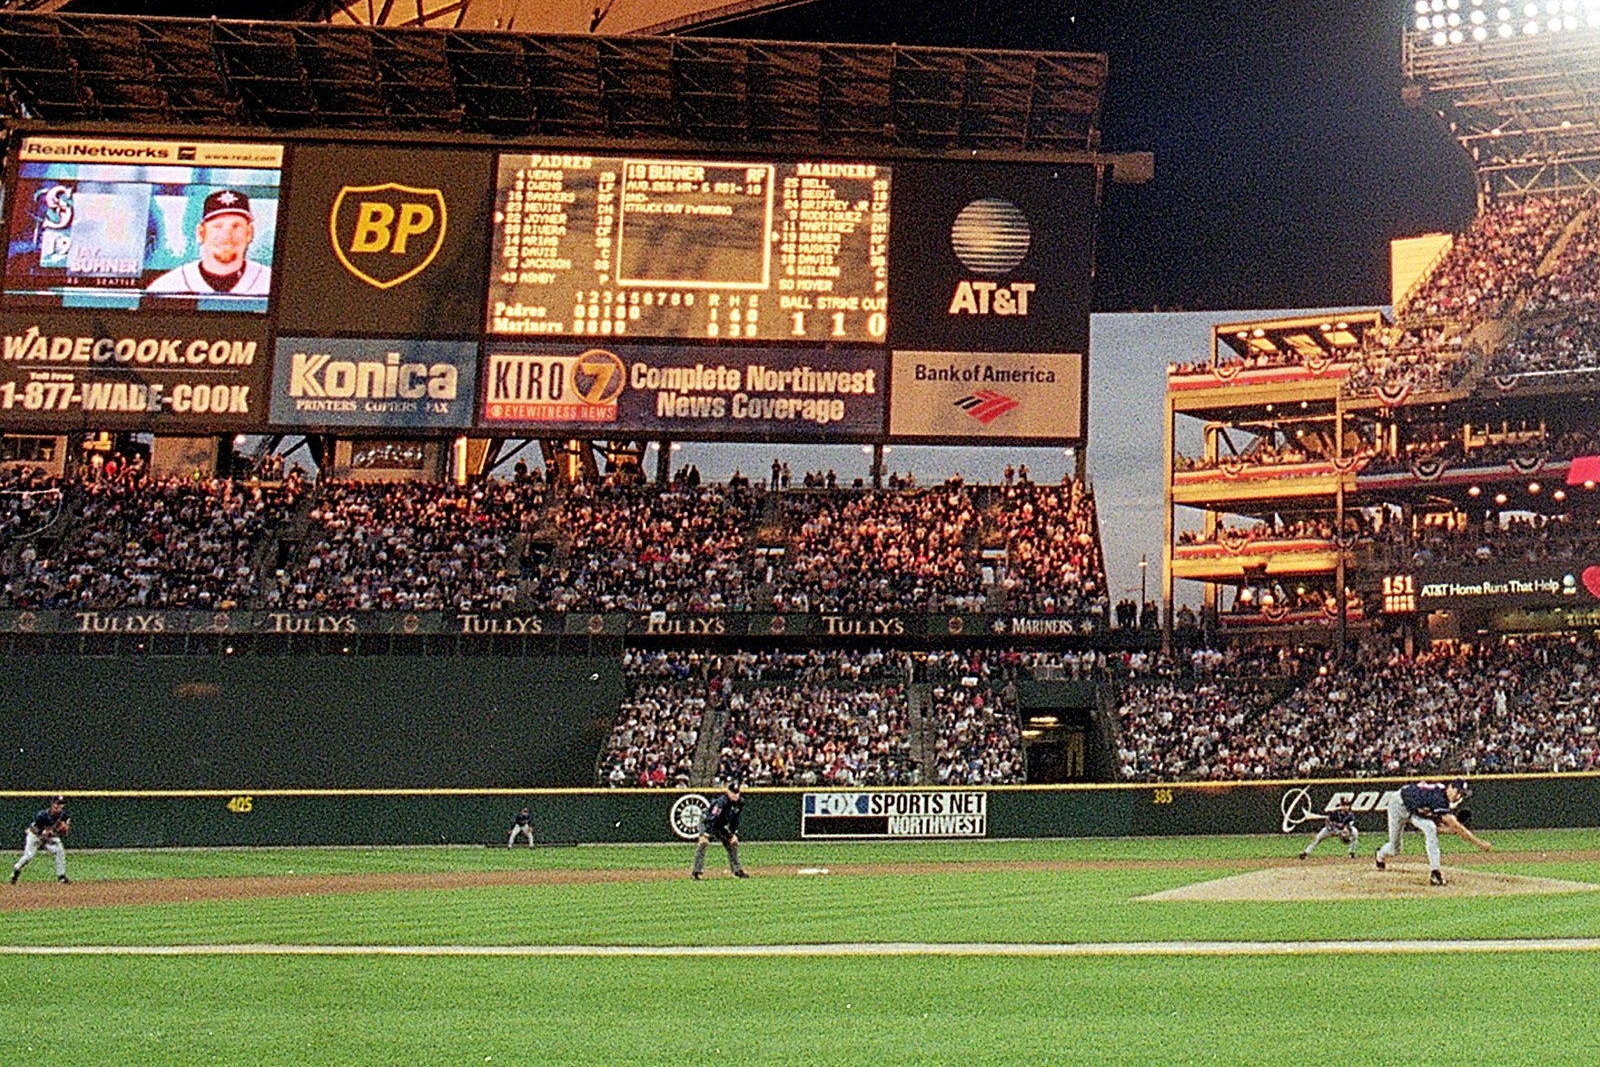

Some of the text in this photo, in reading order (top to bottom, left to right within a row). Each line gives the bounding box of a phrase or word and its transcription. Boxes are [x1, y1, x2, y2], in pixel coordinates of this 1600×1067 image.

[28, 142, 169, 159] RealNetworks
[531, 155, 592, 169] PADRES
[797, 163, 876, 178] MARINERS
[628, 165, 766, 183] 19 BUHNER RF
[802, 179, 830, 189] BELL
[525, 192, 575, 202] SANDERS
[525, 203, 561, 213] NEVIN
[350, 202, 434, 253] BP
[48, 237, 71, 255] 19
[71, 258, 137, 273] BUHNER
[780, 296, 887, 311] BALL STRIKE OUT
[950, 281, 1035, 315] AT&T
[494, 302, 546, 317] Padres
[493, 318, 564, 333] Mariners
[791, 311, 887, 337] 1 1 0
[3, 333, 257, 365] WADECOOK.COM
[290, 352, 458, 400] Konica
[495, 361, 615, 401] KIRO 7
[631, 362, 875, 394] Complete Northwest
[916, 364, 1056, 383] Bank of America
[1, 381, 249, 414] 1-877-WADE-COOK
[296, 399, 357, 412] PRINTERS
[504, 405, 614, 420] EYEWITNESS NEWS
[657, 392, 844, 423] News Coverage
[1382, 575, 1414, 595] 151
[1421, 583, 1449, 597] AT&T
[1450, 582, 1482, 596] Home
[1483, 582, 1508, 594] Runs
[1508, 580, 1533, 593] That
[1535, 579, 1560, 594] Help
[1013, 618, 1073, 634] MARINERS
[225, 796, 253, 813] 405
[816, 794, 983, 814] FOX SPORTS NET
[1153, 788, 1173, 804] 385
[888, 816, 983, 835] NORTHWEST
